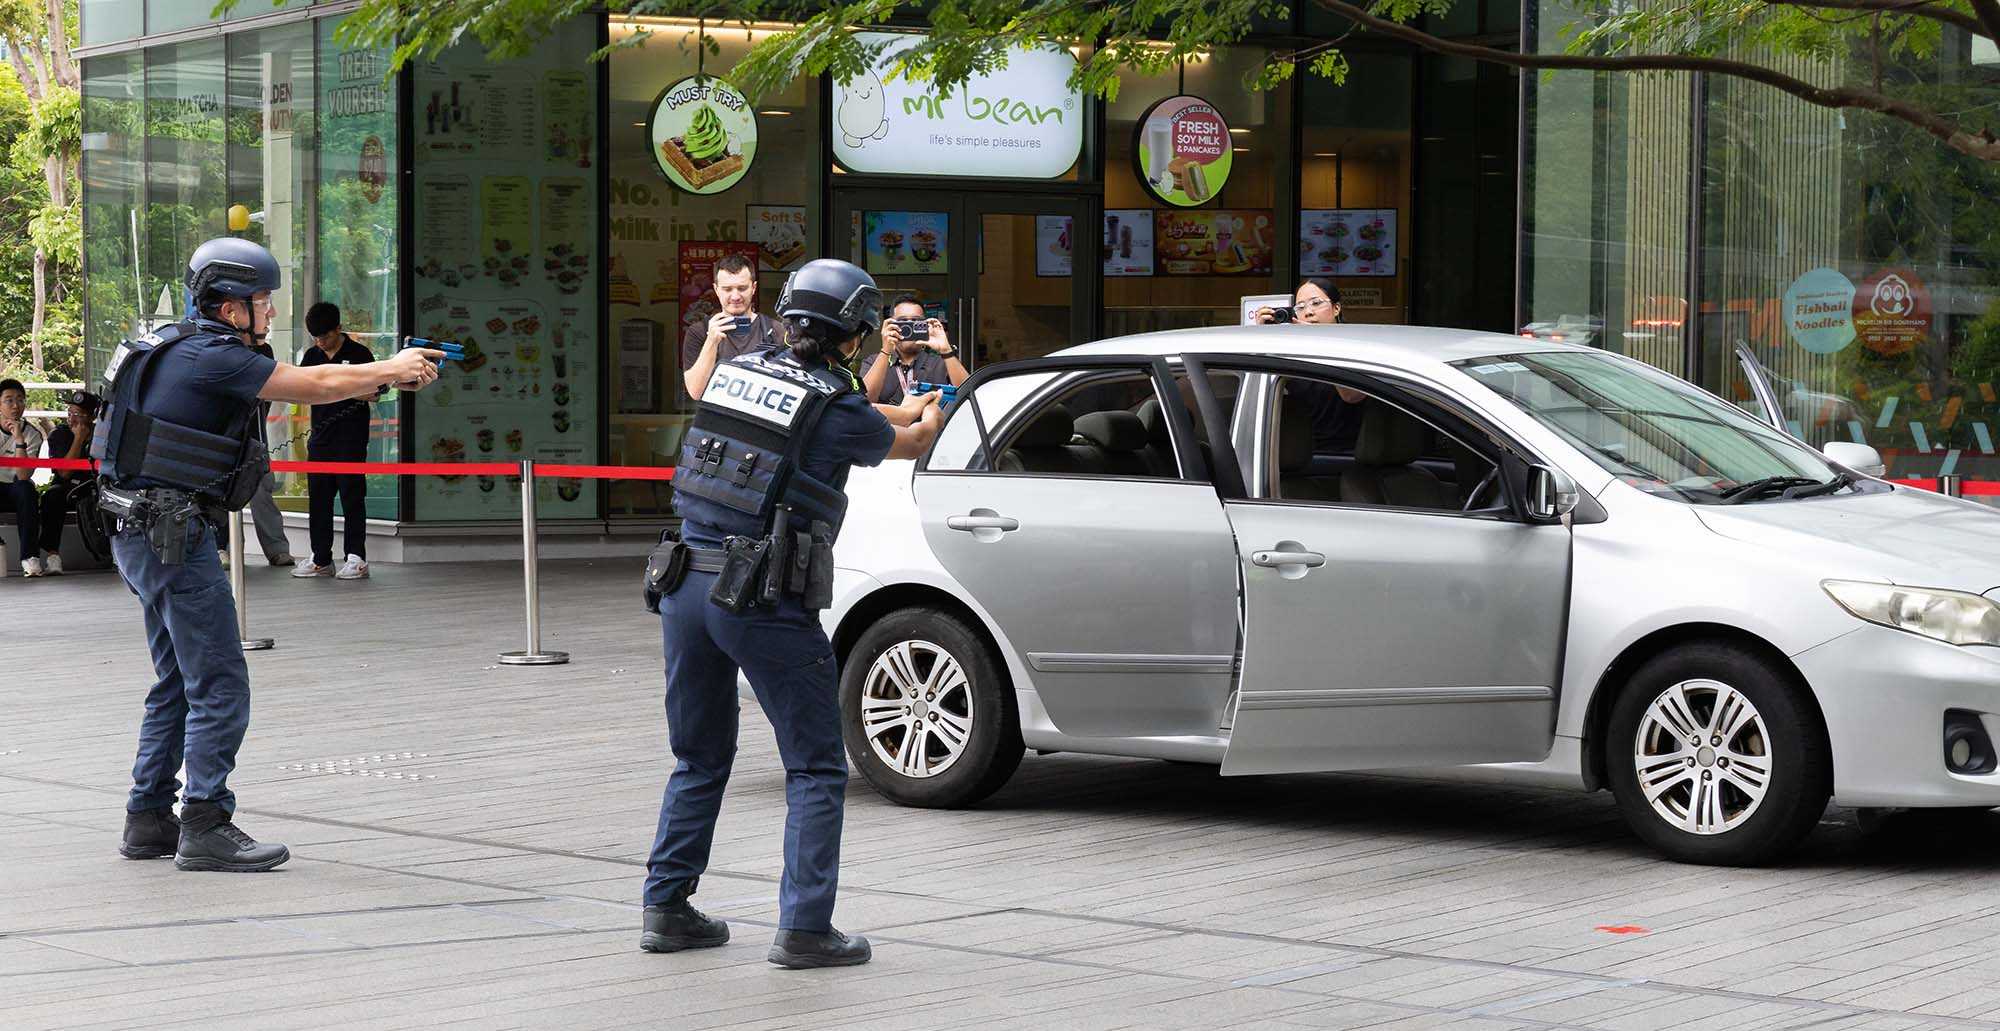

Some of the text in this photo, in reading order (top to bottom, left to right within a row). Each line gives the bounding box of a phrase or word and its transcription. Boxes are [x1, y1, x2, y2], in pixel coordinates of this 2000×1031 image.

[338, 49, 376, 83] TREAT
[178, 93, 217, 115] MATCHA
[328, 84, 386, 119] YOURSELF
[666, 86, 744, 113] MUST TRY
[903, 79, 1064, 126] mr bean
[1188, 105, 1212, 114] SELLER
[1178, 121, 1219, 135] FRESH
[929, 134, 1041, 149] life's simple pleasures
[1177, 134, 1220, 146] SOY MILK
[1183, 146, 1221, 155] PANCAKES
[611, 178, 660, 206] No.
[761, 211, 789, 223] Soft
[670, 216, 696, 241] in
[706, 218, 738, 242] SG
[1796, 301, 1847, 315] Fishball
[1794, 317, 1847, 330] Noodles
[711, 373, 799, 415] POLICE
